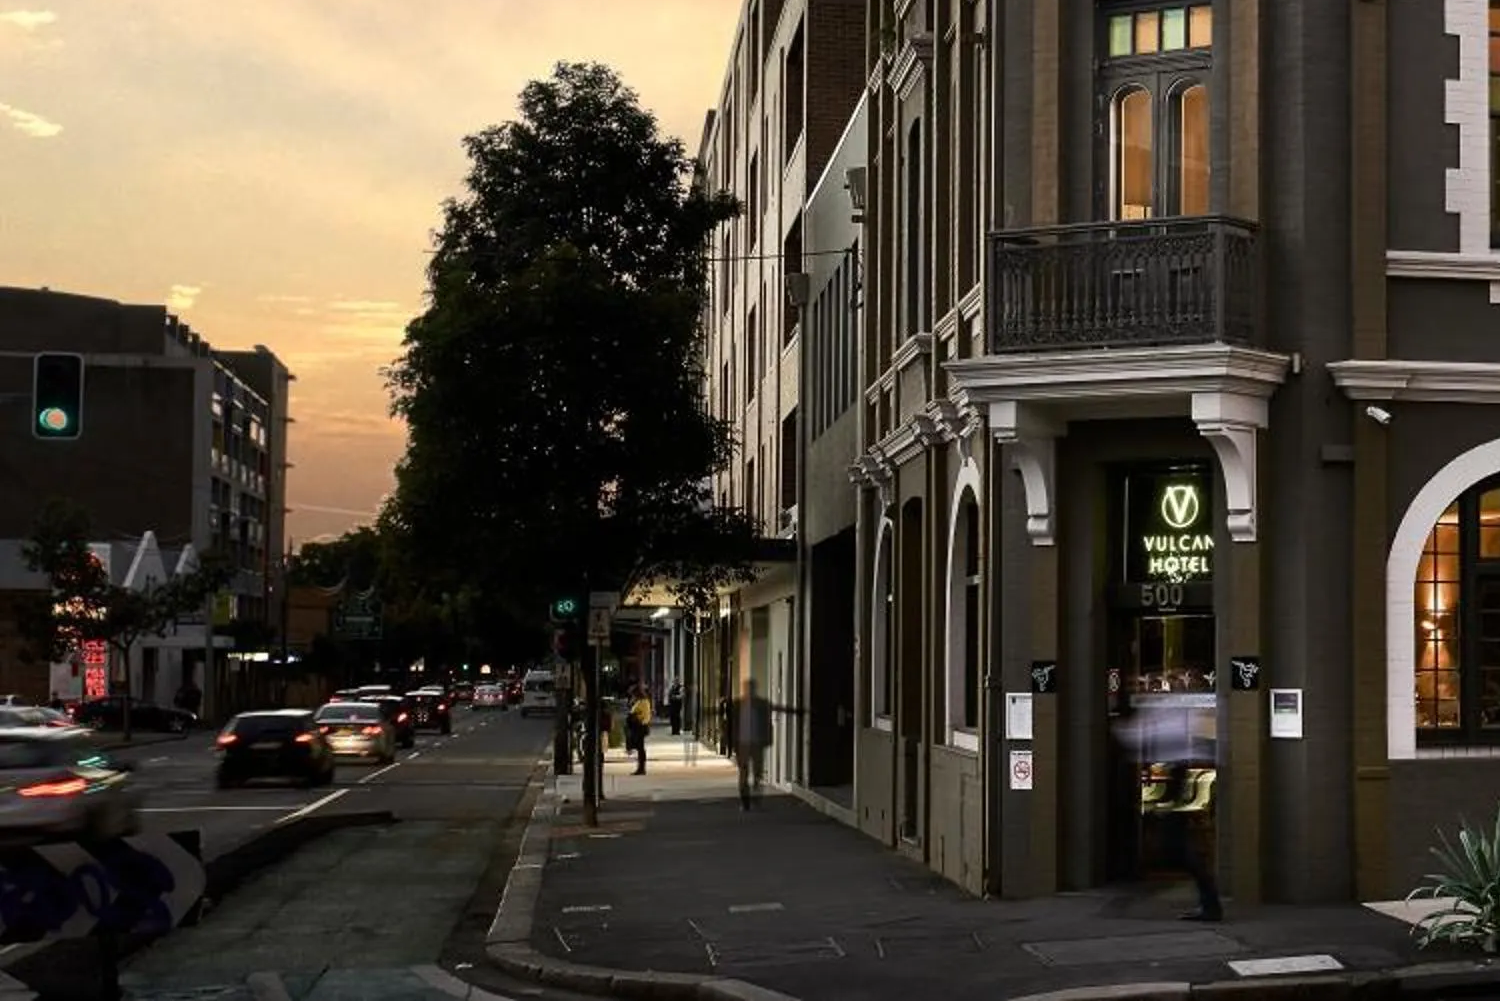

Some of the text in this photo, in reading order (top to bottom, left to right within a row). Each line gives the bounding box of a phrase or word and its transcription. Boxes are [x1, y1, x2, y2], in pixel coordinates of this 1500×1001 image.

[1164, 485, 1196, 526] V
[1148, 556, 1210, 573] HOTEL
[1141, 584, 1184, 606] 500
